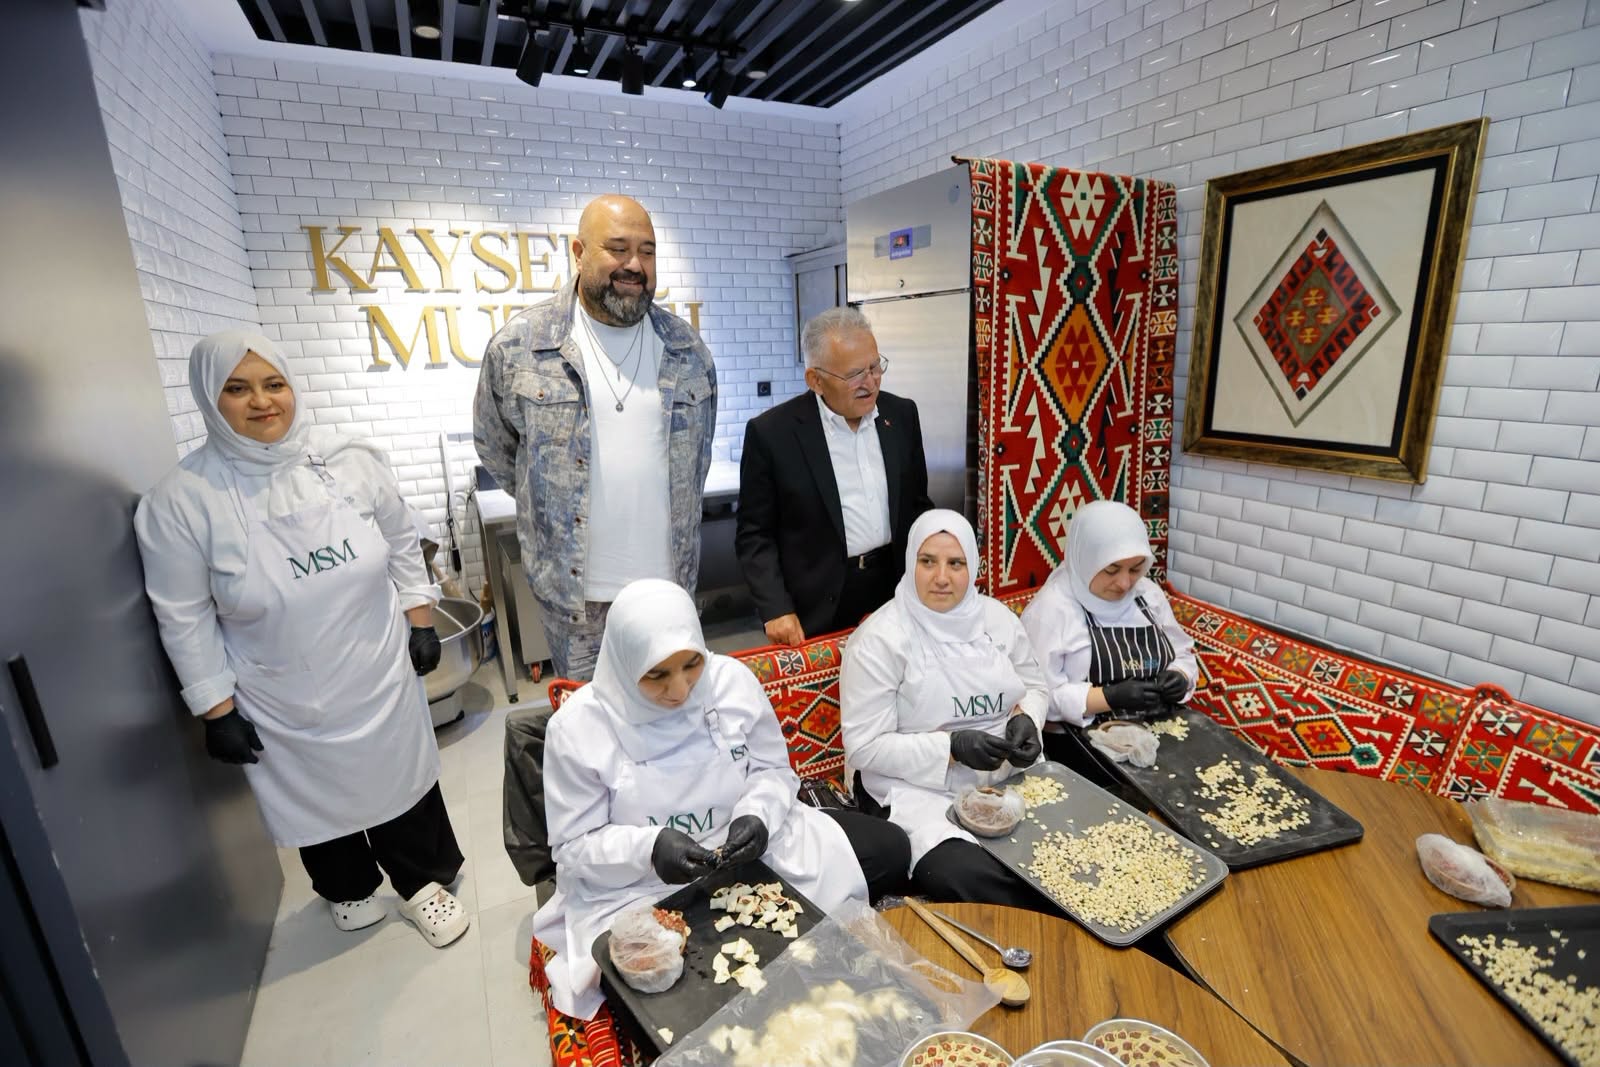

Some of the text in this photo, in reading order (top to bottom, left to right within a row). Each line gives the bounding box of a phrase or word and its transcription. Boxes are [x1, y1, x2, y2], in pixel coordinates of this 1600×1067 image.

[301, 225, 578, 294] KAYSE
[286, 538, 358, 579] MSM
[951, 692, 1004, 718] MSM
